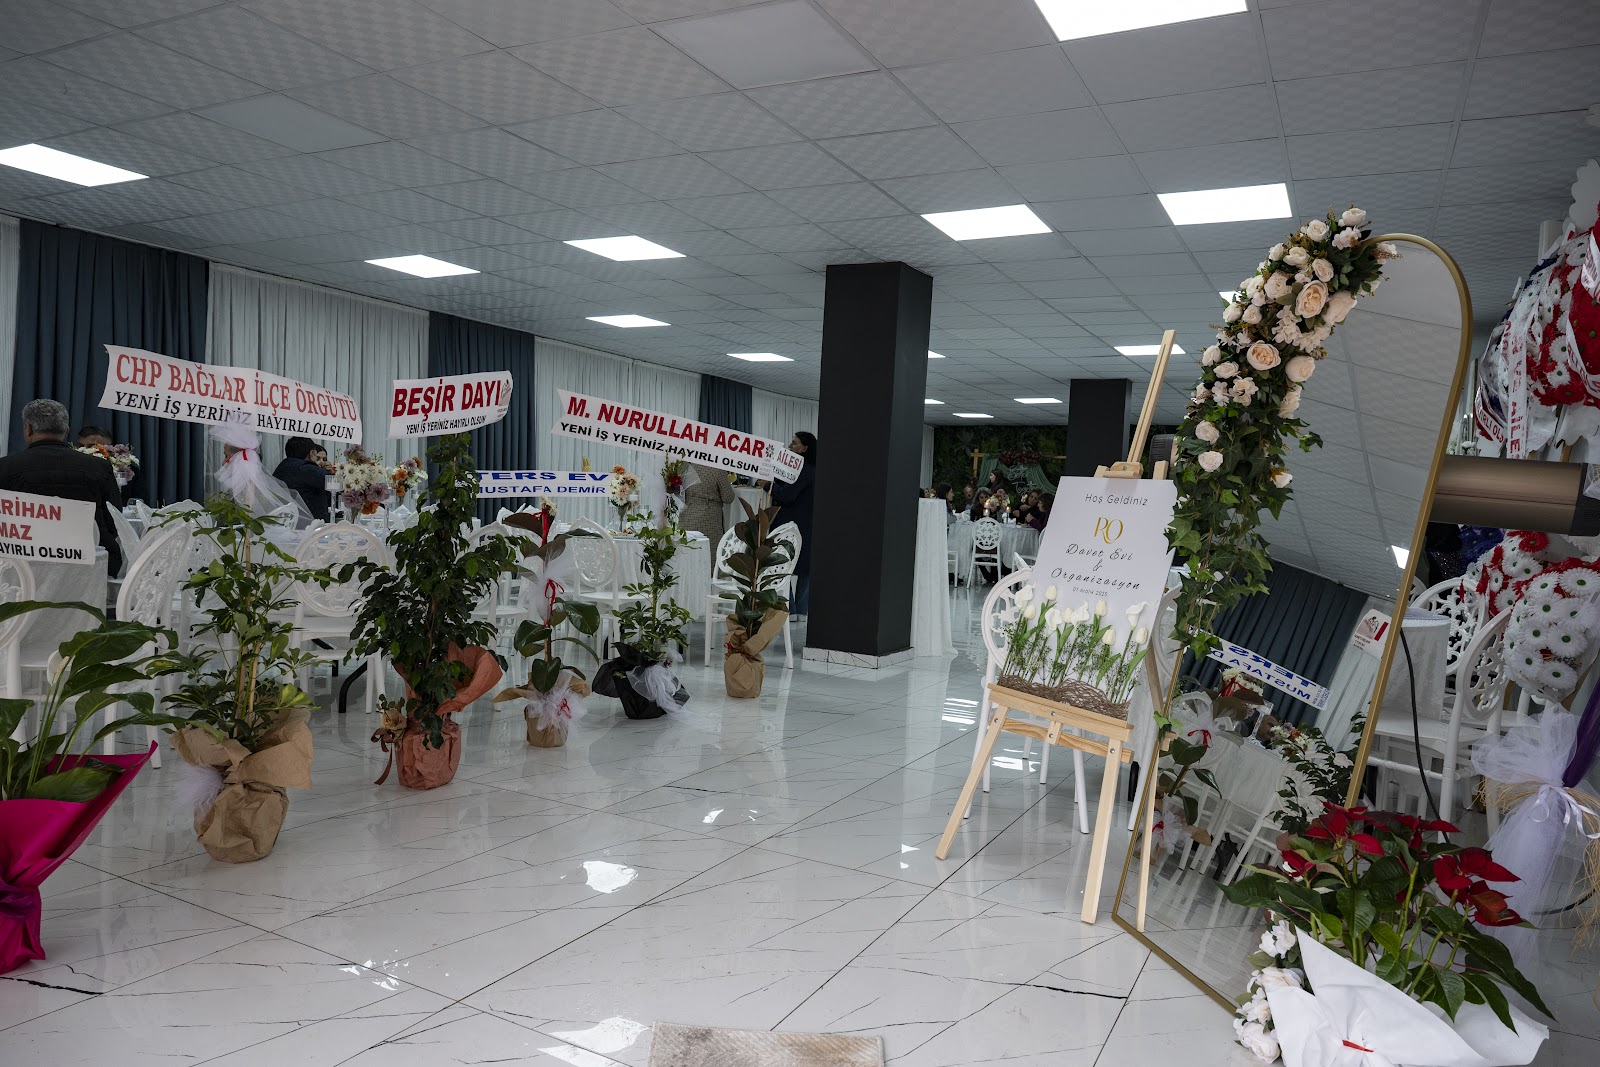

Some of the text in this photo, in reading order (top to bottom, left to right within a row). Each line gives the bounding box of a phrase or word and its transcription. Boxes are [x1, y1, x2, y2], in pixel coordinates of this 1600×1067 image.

[116, 353, 357, 422] CHP BAĞLAR İLÇE ÖRGÜTÜ
[392, 378, 501, 422] BEŞİR DAYI
[114, 390, 354, 440] YENİ İŞ YERİNİZ HAYIRLI OLSUN
[406, 421, 420, 435] YENİ
[567, 396, 590, 419] M.
[597, 403, 709, 445] NURULLAH
[714, 430, 765, 459] ACAR
[560, 422, 592, 436] YENİ
[596, 427, 609, 441] İŞ
[613, 433, 665, 452] YERİNİZ
[668, 445, 719, 464] HAYIRLI
[722, 457, 759, 473] OLSUN
[557, 485, 606, 494] DEMİR
[1085, 493, 1148, 506] Hoş Geldiniz
[0, 496, 62, 521] RİHAN
[38, 546, 82, 560] OLSUN
[1065, 543, 1134, 561] Davet Evi
[1050, 567, 1141, 590] Organizasyon
